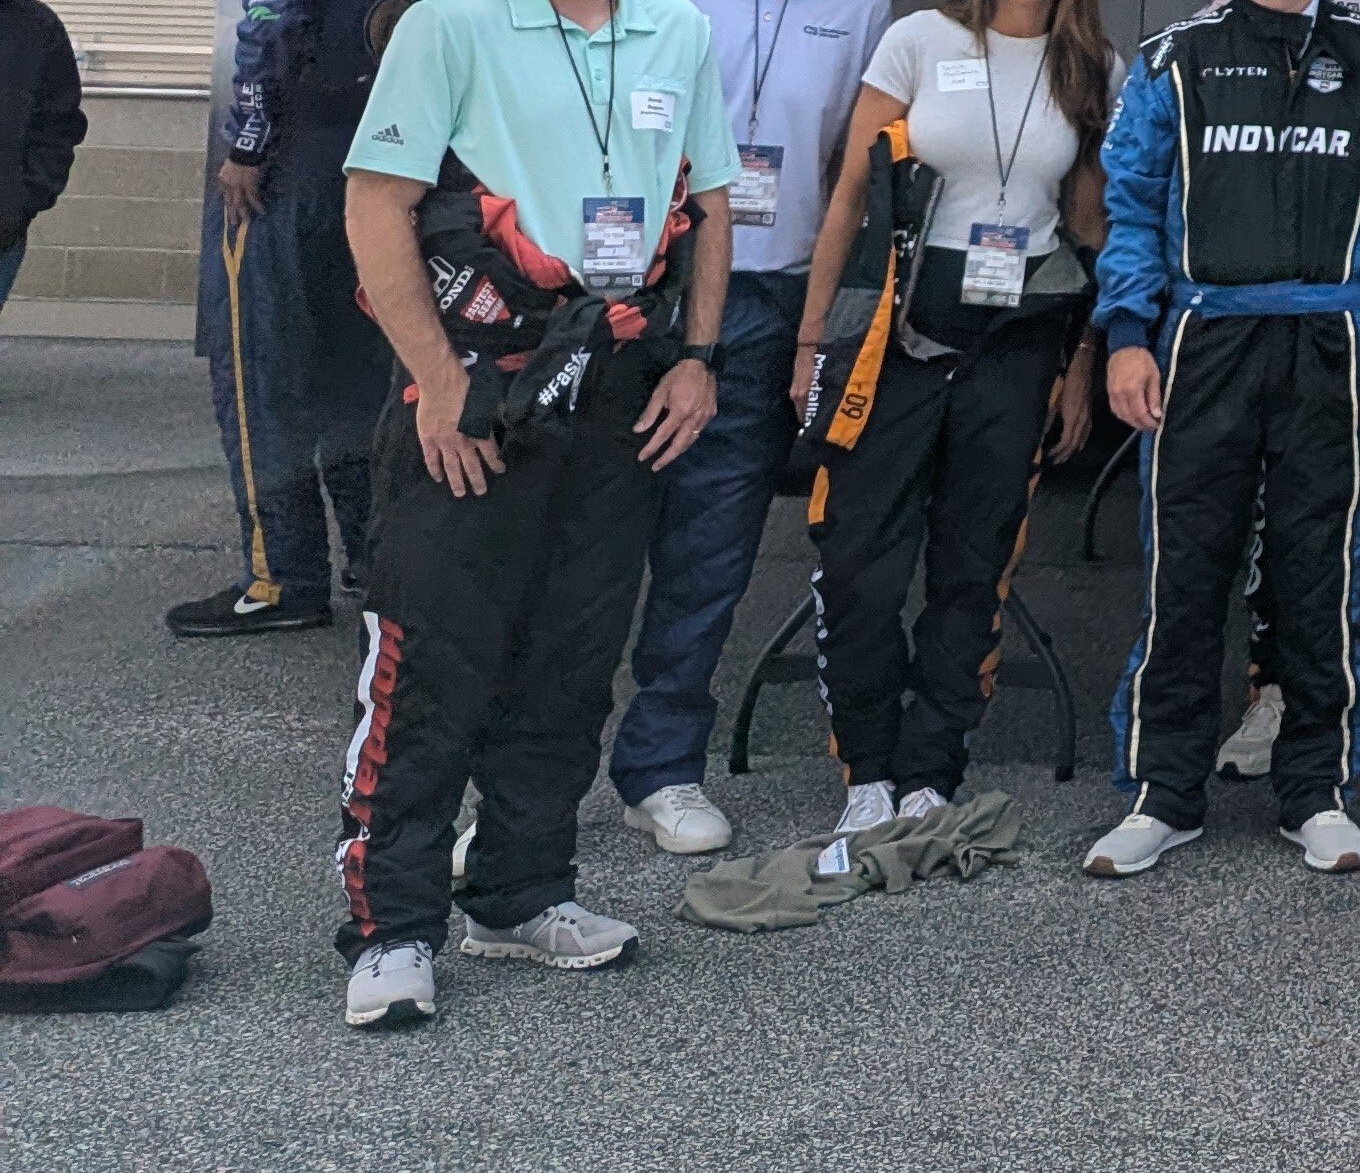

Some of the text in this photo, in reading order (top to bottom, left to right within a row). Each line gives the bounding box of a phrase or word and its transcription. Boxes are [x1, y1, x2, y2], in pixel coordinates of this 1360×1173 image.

[1215, 66, 1268, 78] LYTEN
[371, 133, 405, 146] adidas
[1203, 125, 1351, 157] INDYCAR
